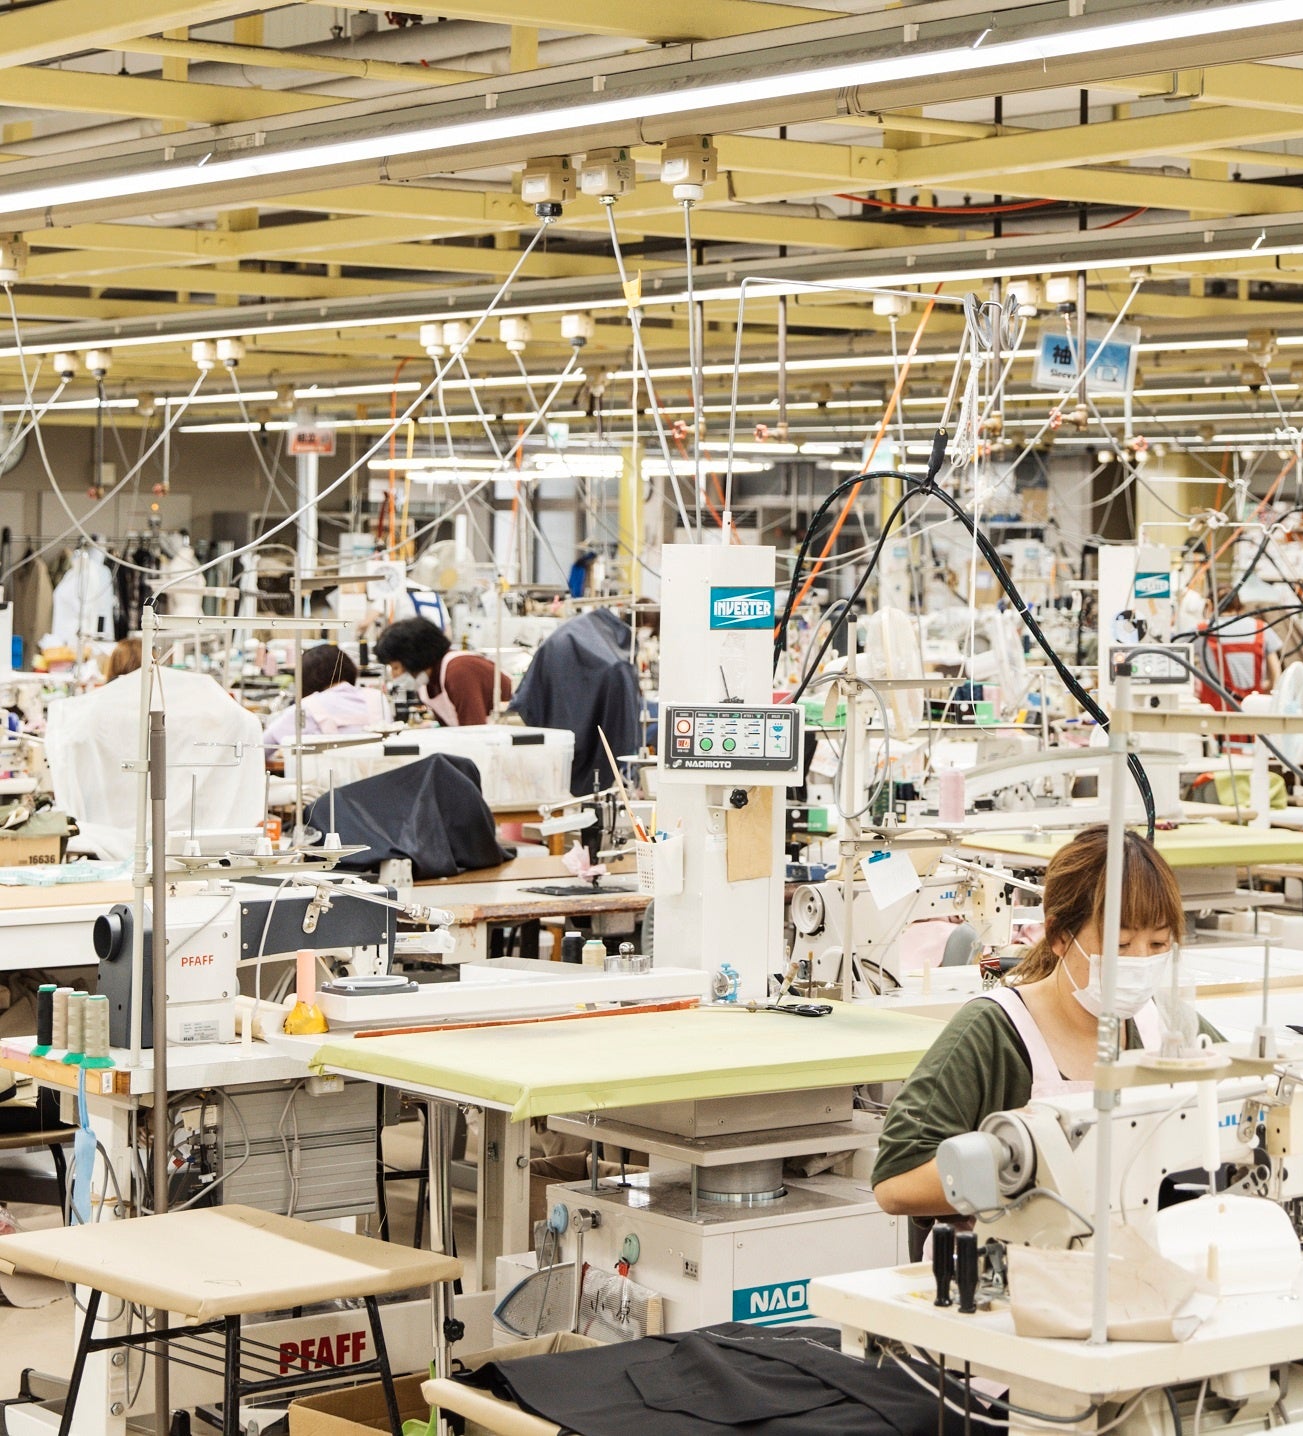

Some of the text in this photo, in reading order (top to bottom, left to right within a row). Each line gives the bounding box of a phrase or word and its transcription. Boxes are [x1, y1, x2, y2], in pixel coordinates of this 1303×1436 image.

[714, 601, 771, 616] INVERTER
[685, 760, 731, 769] NAOMOTO
[940, 890, 971, 899] JUI
[181, 955, 214, 967] PFAFF
[1218, 1110, 1264, 1127] JUI
[750, 1283, 808, 1314] NAO
[280, 1331, 366, 1374] PFAFF
